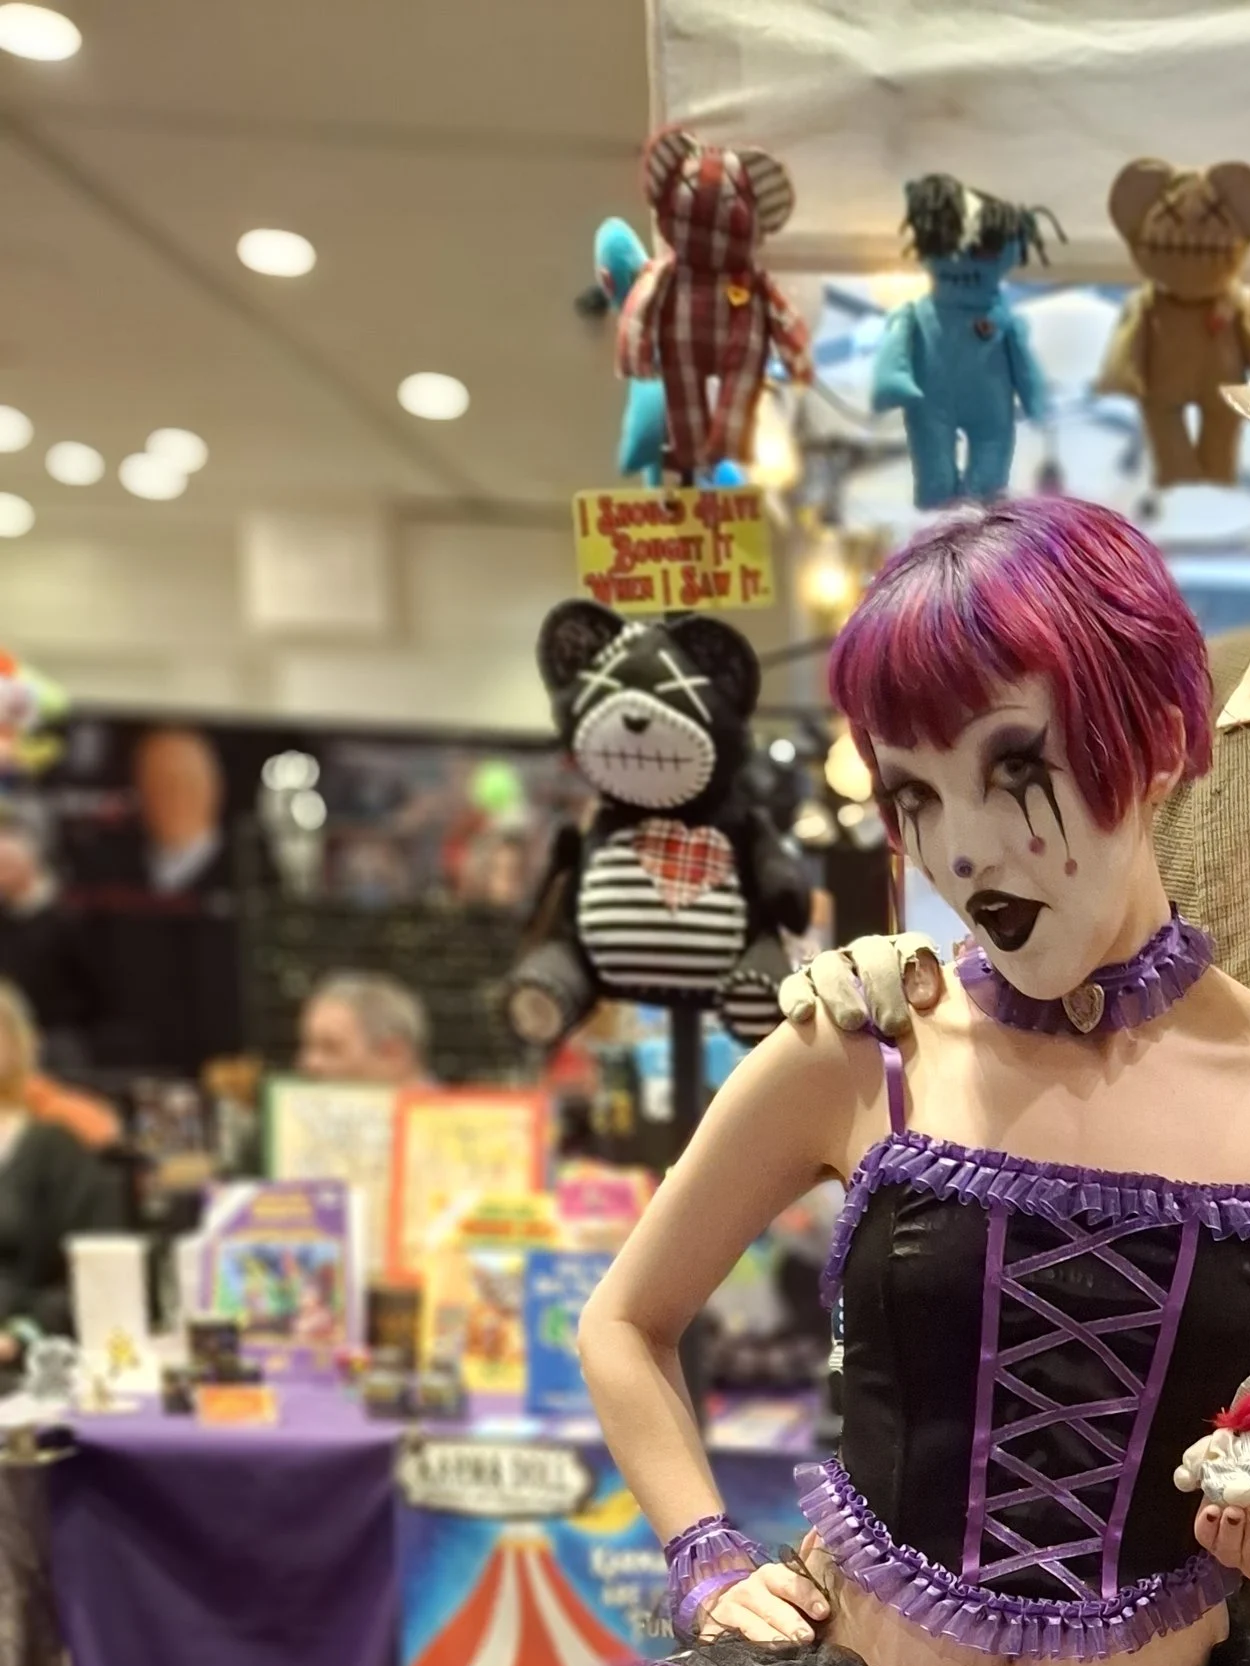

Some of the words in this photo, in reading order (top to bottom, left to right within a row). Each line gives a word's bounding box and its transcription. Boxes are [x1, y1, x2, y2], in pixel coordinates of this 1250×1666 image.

[578, 497, 589, 538] I
[608, 531, 704, 574] BOUGHT
[712, 529, 735, 566] IT
[583, 571, 655, 606] WHEN
[661, 567, 673, 606] I
[680, 564, 731, 606] SAW
